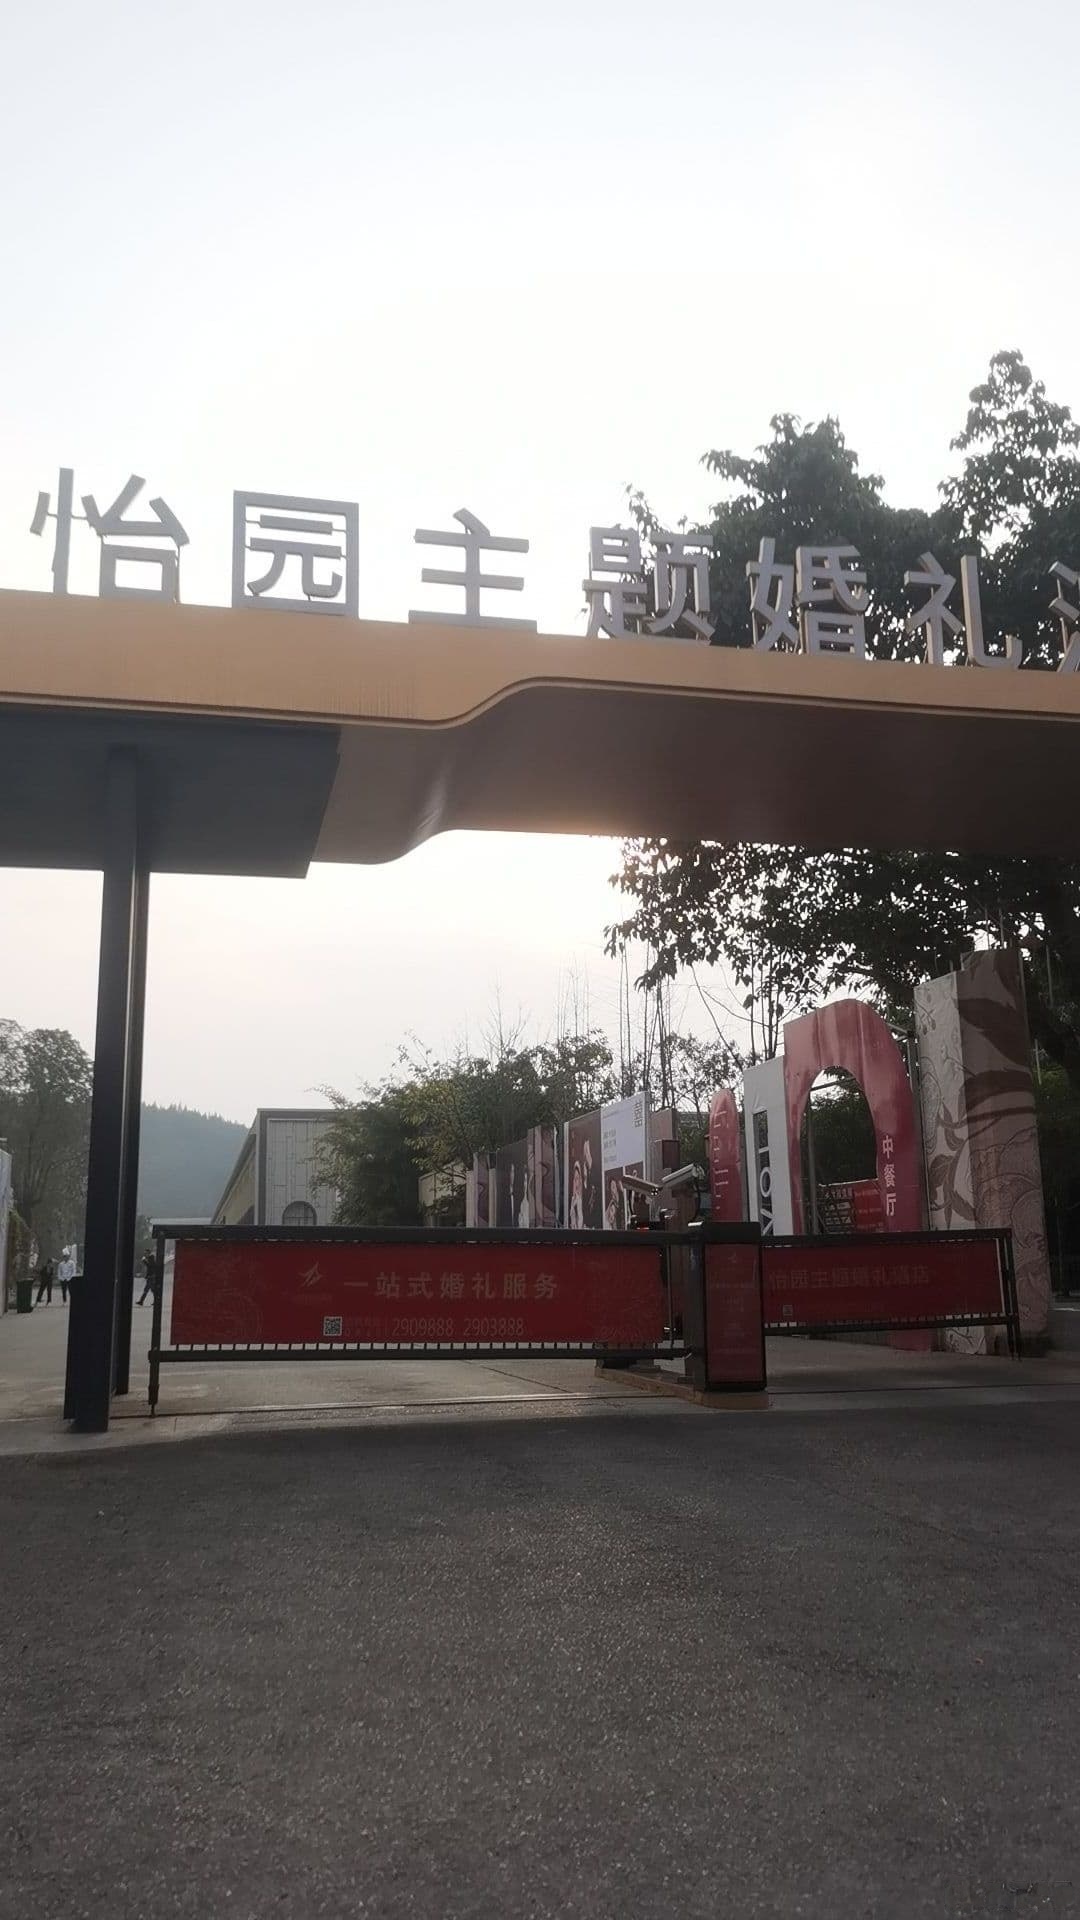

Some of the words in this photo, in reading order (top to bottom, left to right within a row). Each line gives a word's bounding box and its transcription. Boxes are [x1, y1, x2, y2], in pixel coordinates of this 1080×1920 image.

[29, 467, 1080, 672] 怡园主题婚礼
[882, 1135, 897, 1217] 中餐厅
[344, 1271, 559, 1299] 一站式婚礼服务
